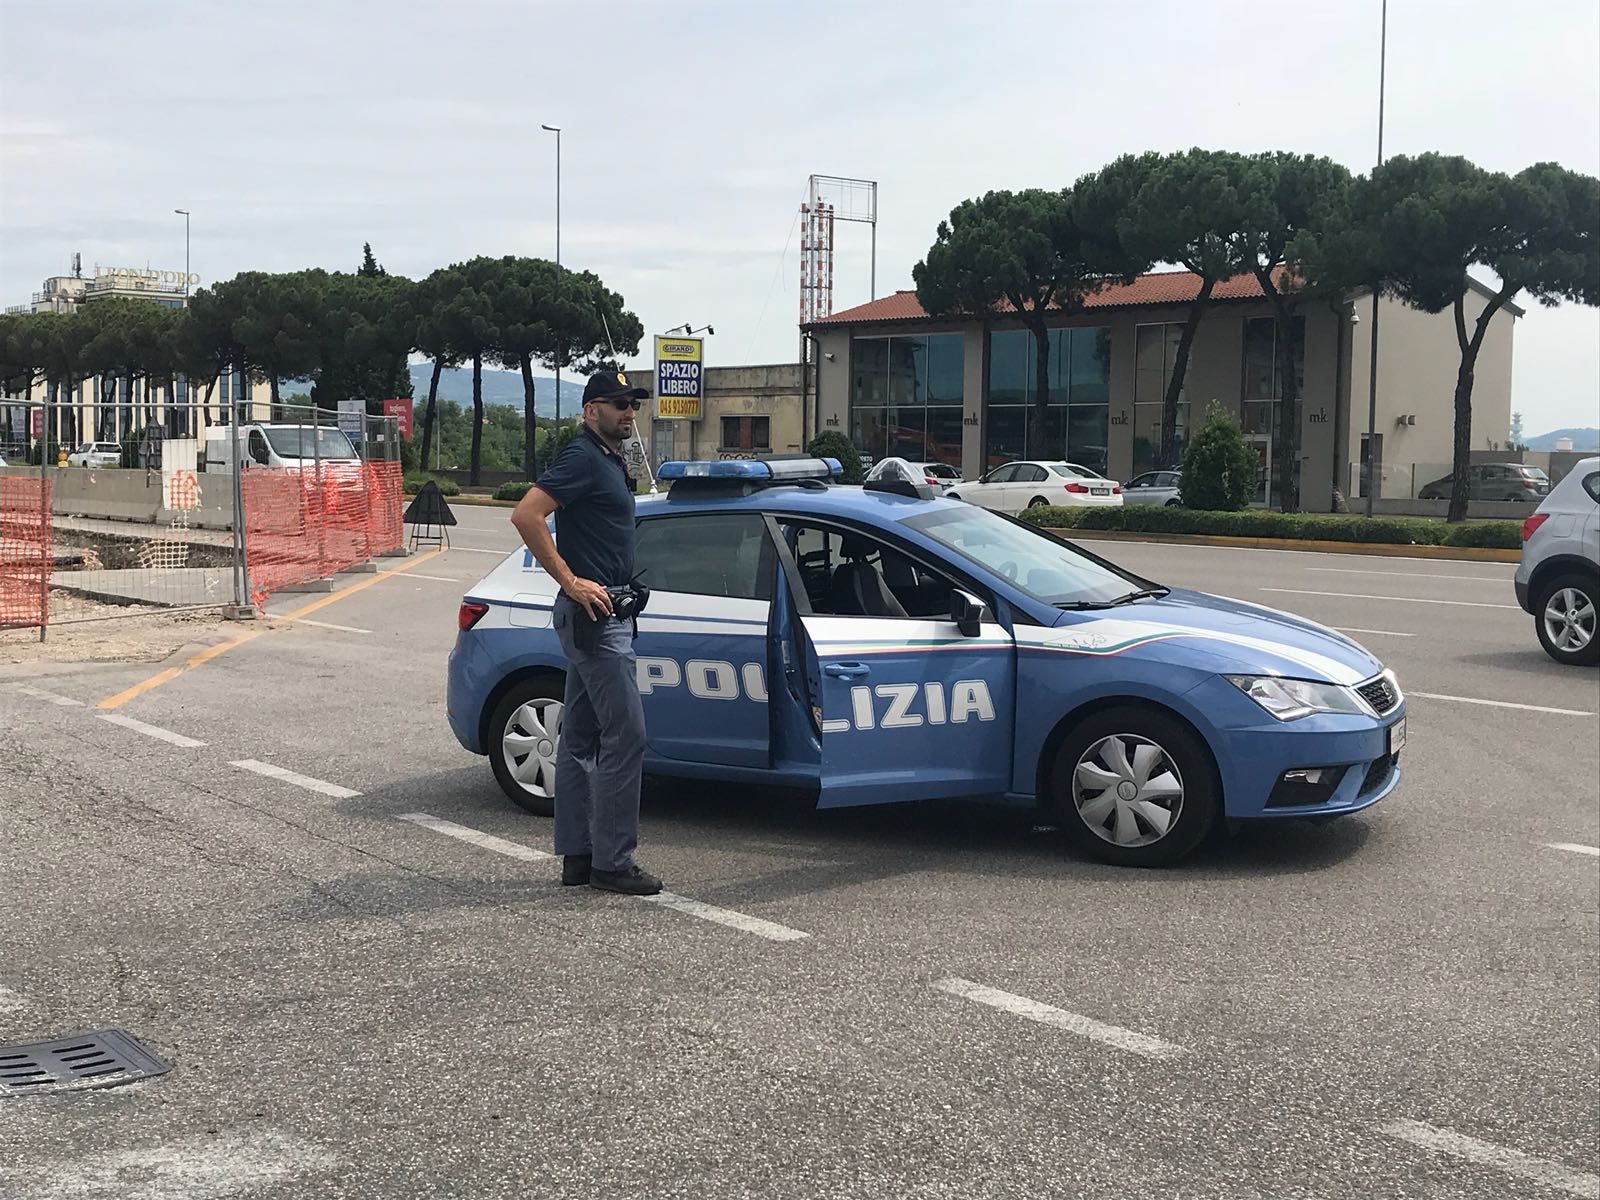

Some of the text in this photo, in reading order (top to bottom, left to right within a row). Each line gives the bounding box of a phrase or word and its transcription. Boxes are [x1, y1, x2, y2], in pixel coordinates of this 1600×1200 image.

[660, 363, 699, 378] SPAZIO
[662, 380, 698, 394] LIBERO
[660, 400, 672, 414] 045
[826, 413, 839, 426] mk
[964, 411, 979, 426] mk
[1111, 410, 1128, 425] mk
[1309, 407, 1328, 423] mk
